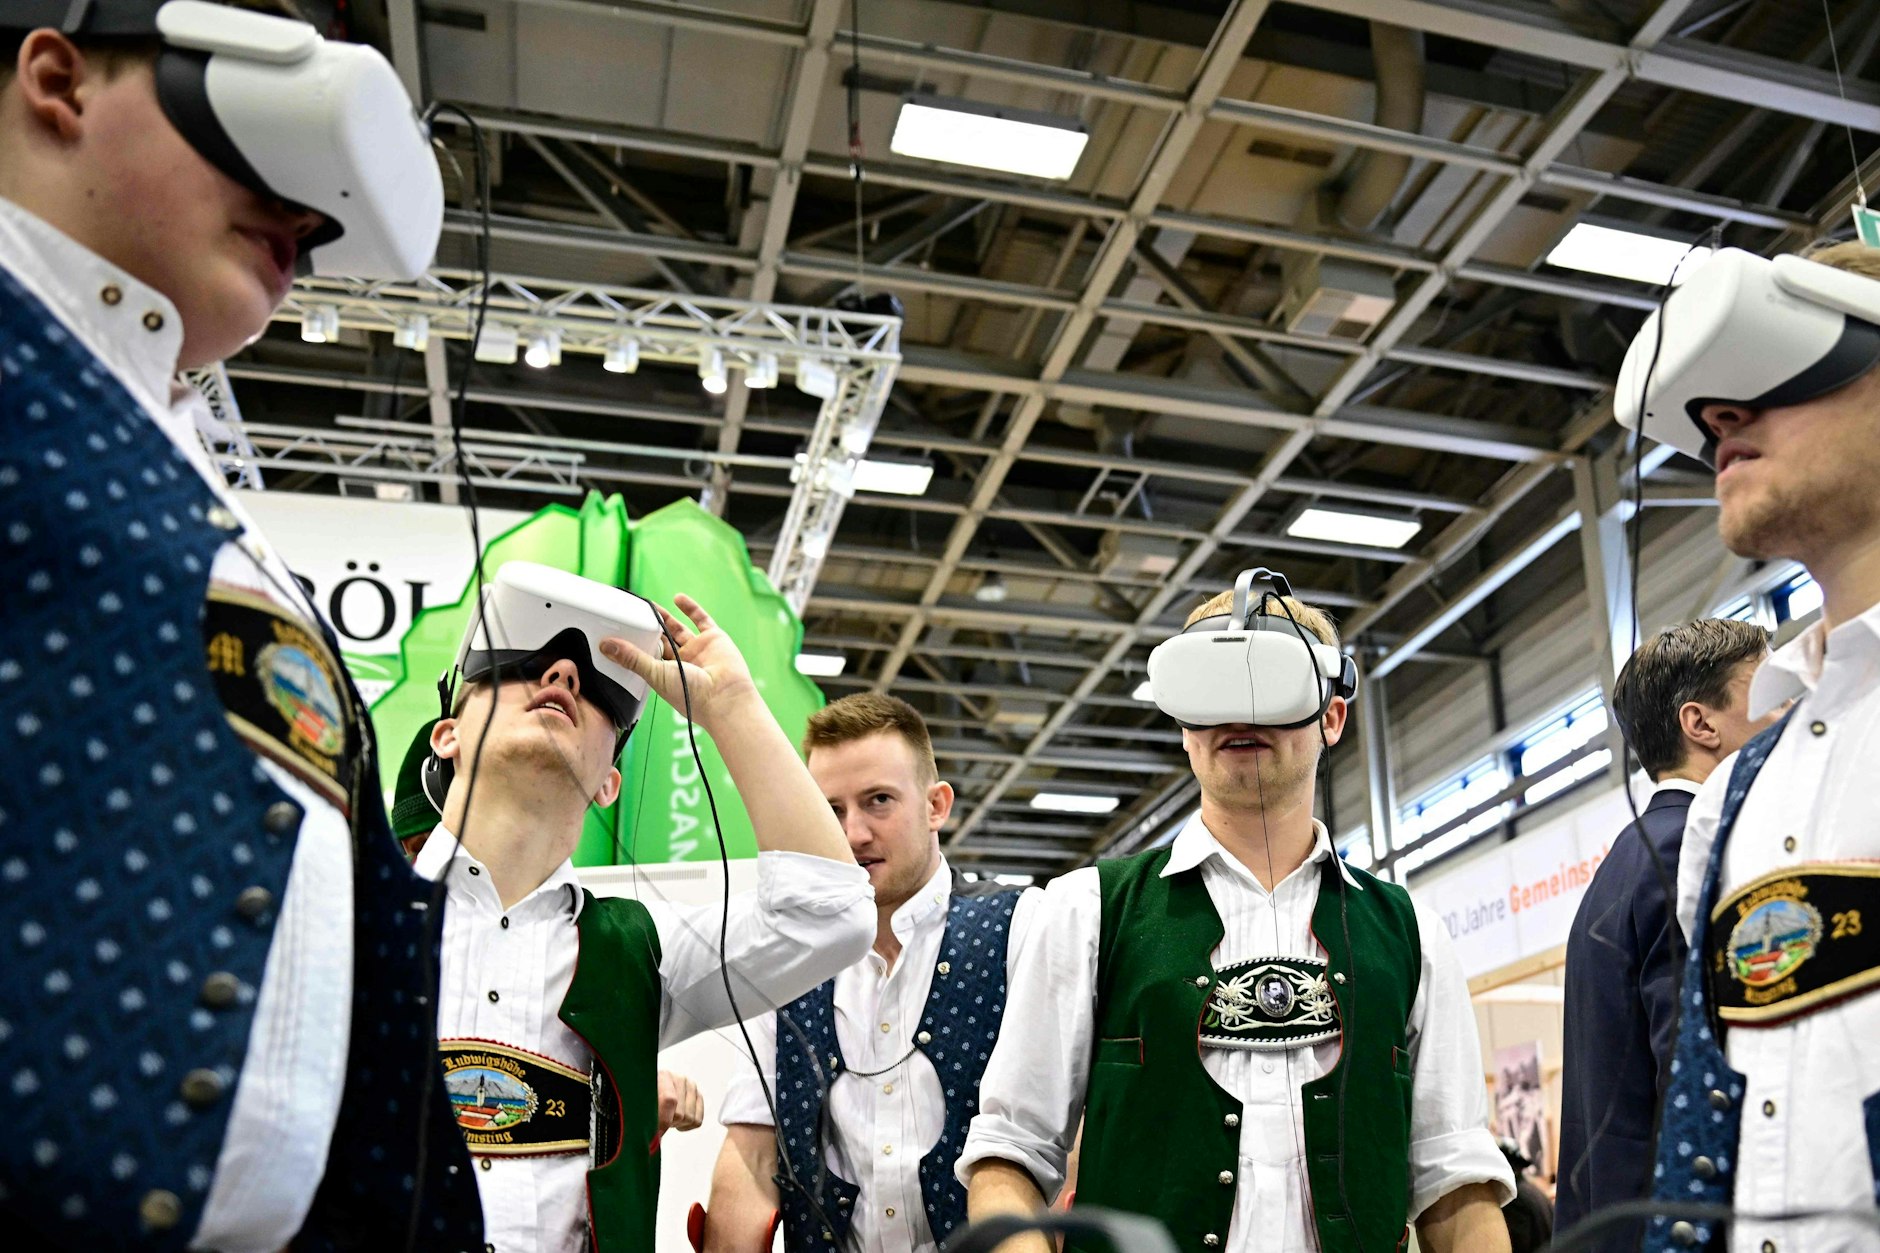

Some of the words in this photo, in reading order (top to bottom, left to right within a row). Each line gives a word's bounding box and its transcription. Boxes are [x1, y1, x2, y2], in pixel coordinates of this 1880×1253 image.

[1462, 897, 1505, 935] Jahre
[1830, 909, 1863, 940] 23
[441, 1052, 527, 1078] Ludwigshöhe
[544, 1098, 567, 1118] 23
